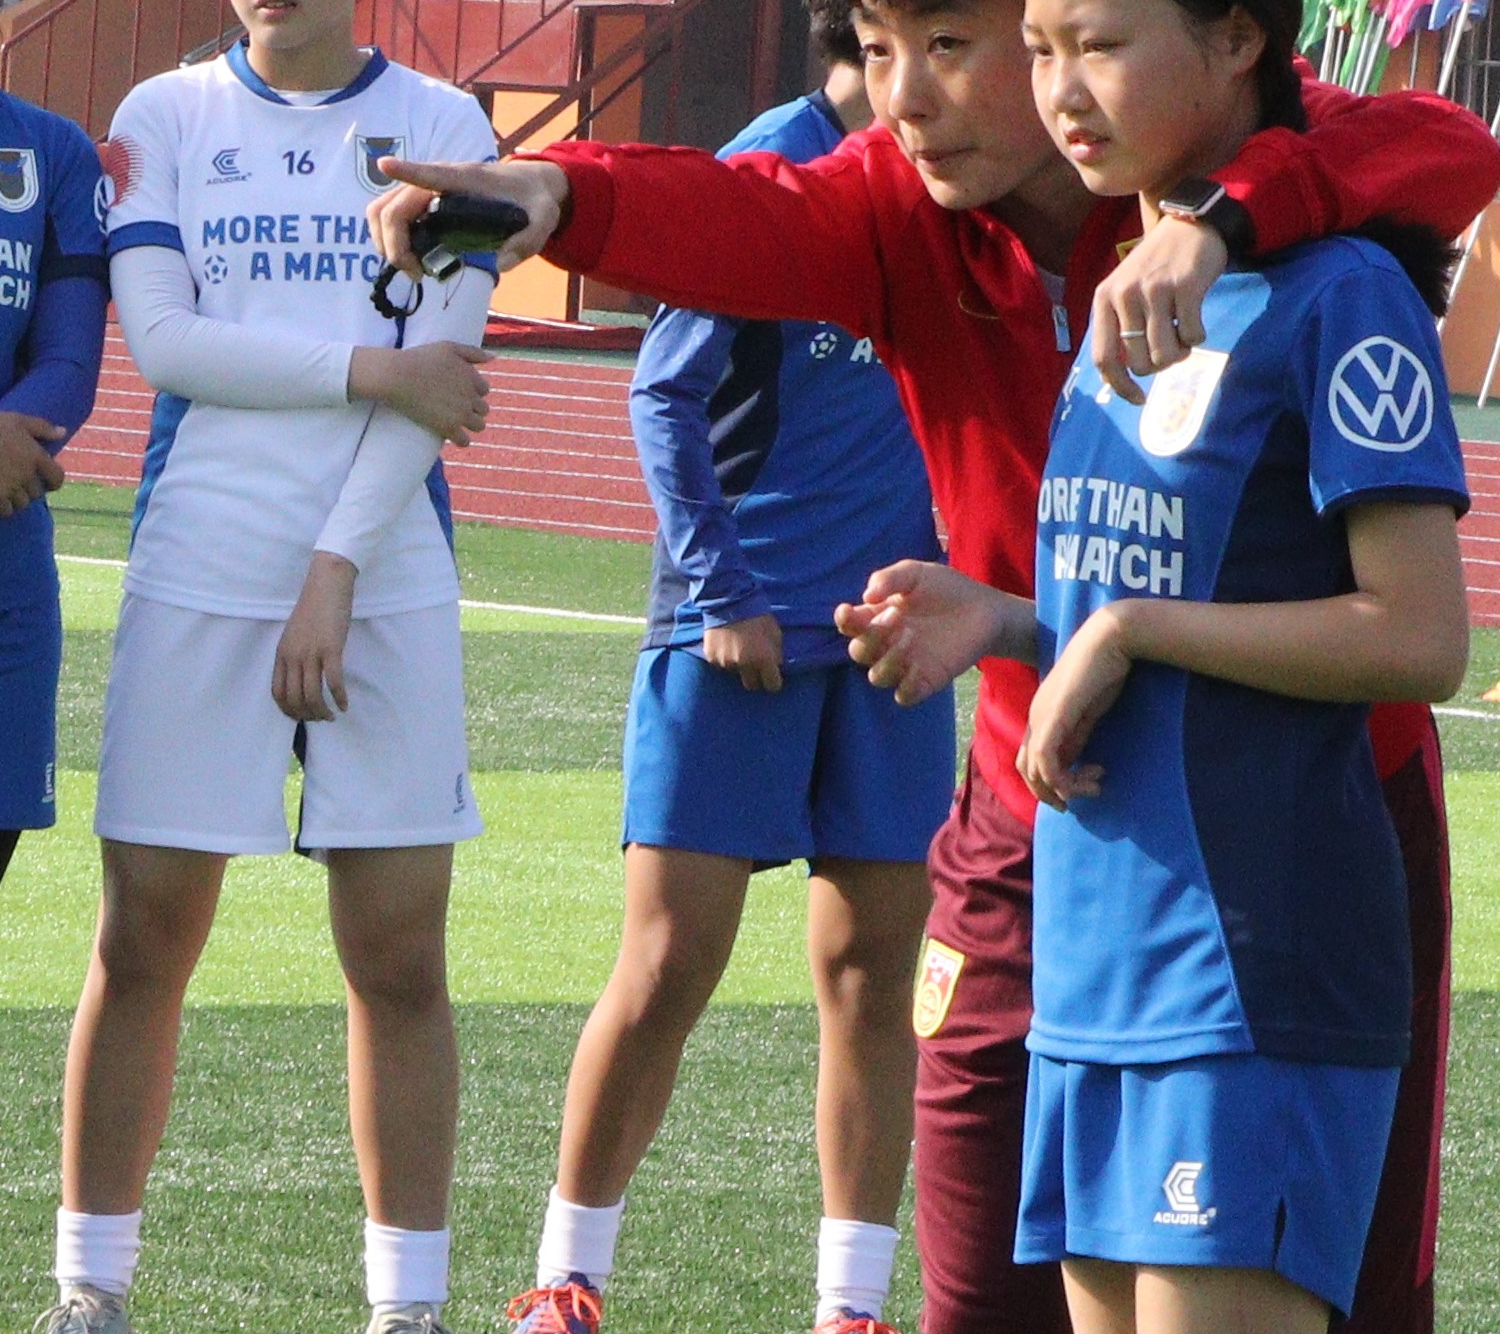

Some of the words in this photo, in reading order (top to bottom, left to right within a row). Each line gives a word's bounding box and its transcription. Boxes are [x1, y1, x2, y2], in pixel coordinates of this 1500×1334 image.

[282, 149, 315, 175] 16
[202, 214, 300, 248] MORE
[250, 251, 272, 281] A
[283, 252, 380, 283] MATC
[850, 337, 872, 363] A
[1038, 477, 1083, 524] ORE
[1087, 478, 1184, 540] THAN
[1054, 534, 1183, 597] MATCH
